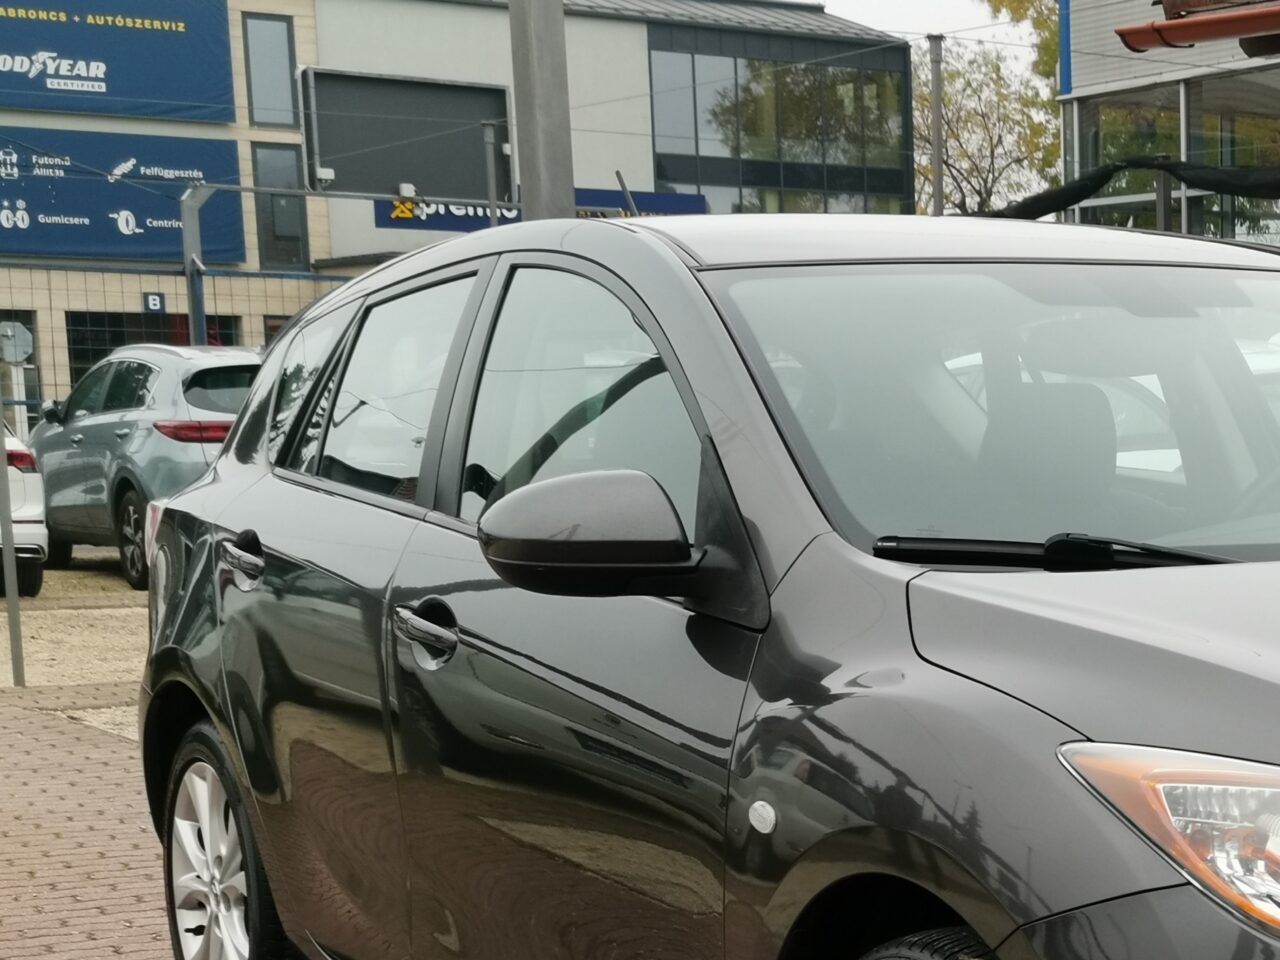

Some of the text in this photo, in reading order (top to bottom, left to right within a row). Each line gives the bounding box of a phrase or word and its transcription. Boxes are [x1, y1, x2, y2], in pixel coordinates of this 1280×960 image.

[87, 14, 186, 32] AUTÓSZERVIZ
[50, 80, 103, 90] CERTIFIED
[140, 166, 204, 179] Felfüggesztés
[38, 214, 90, 225] Gumicsere
[149, 295, 161, 310] B
